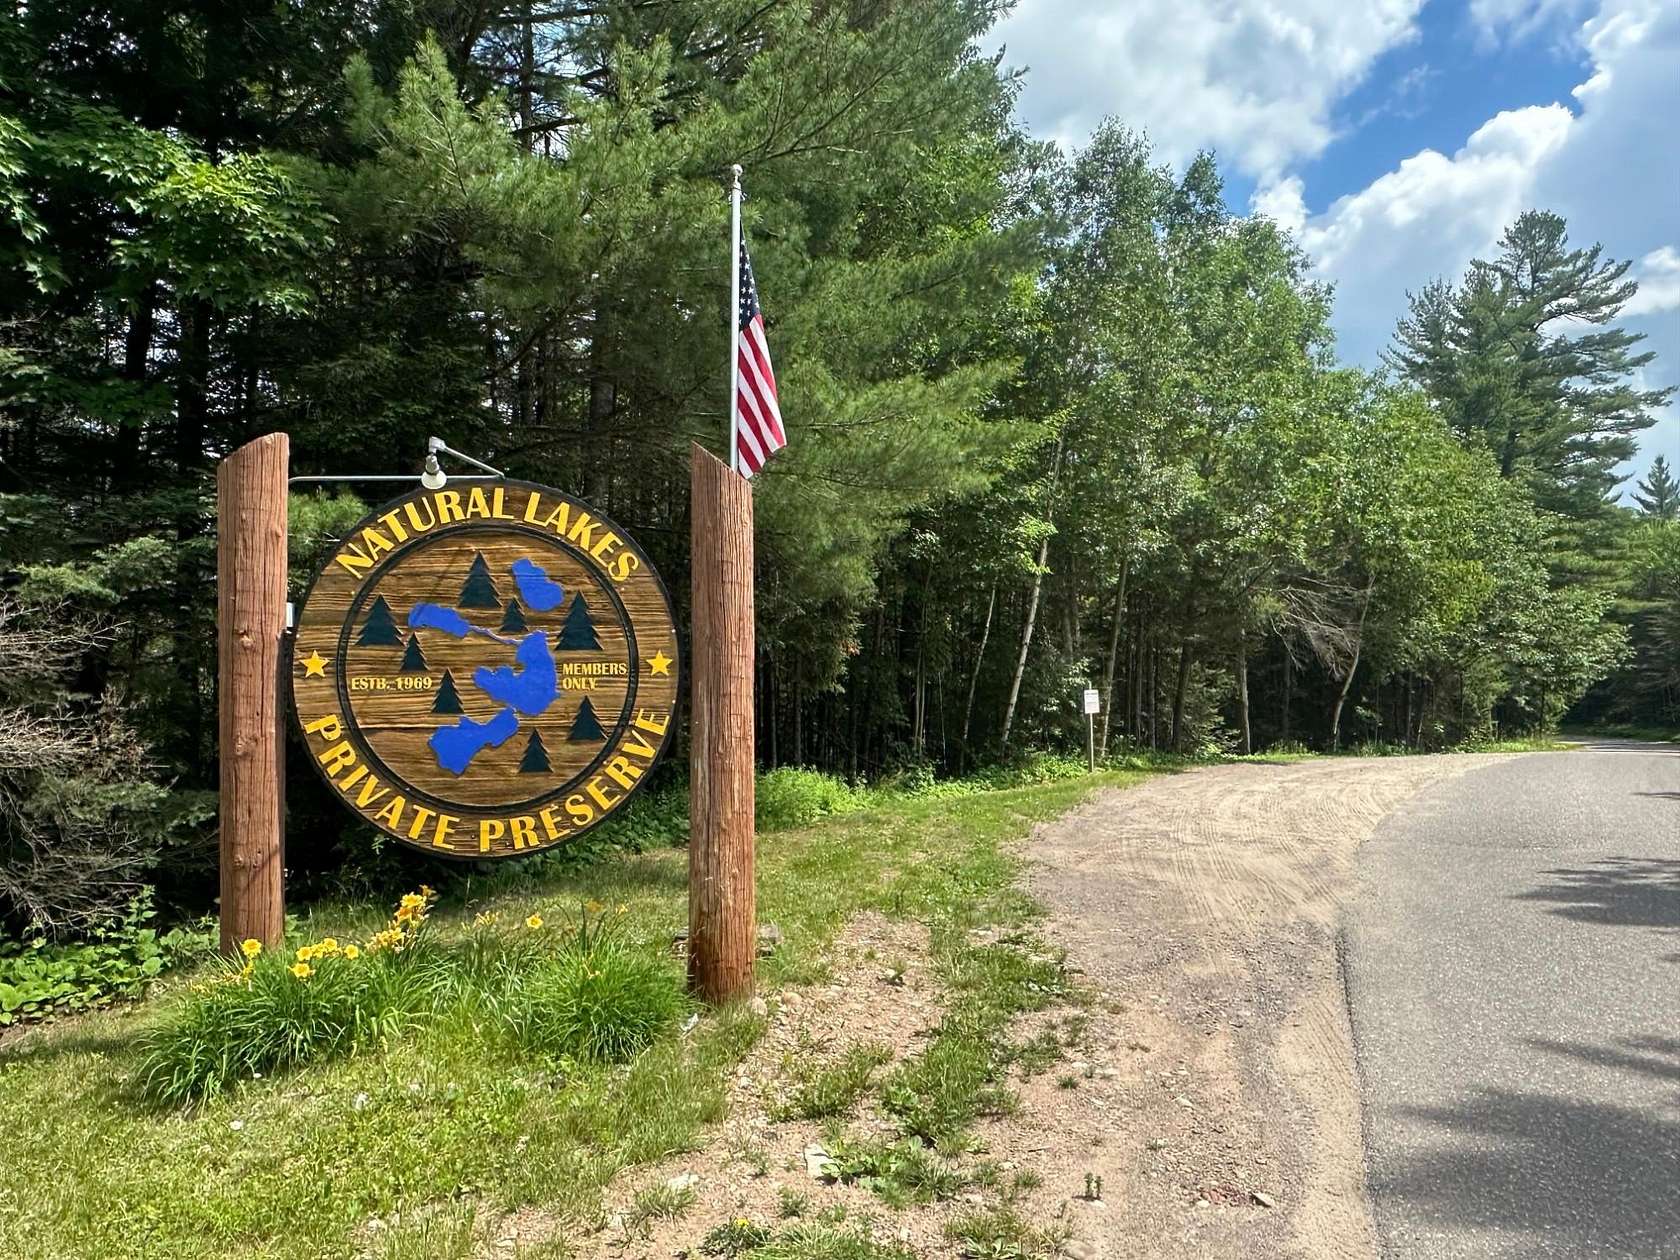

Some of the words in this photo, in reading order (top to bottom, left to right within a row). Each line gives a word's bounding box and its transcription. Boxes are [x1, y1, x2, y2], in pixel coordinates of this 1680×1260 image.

[335, 487, 515, 580] NATURAL
[523, 491, 641, 582] LAKES
[562, 663, 627, 675] MEMBERS
[396, 676, 433, 690] 1969
[562, 677, 597, 690] ONLY
[304, 714, 462, 851] PRIVATE
[479, 708, 670, 853] PRESERVE
